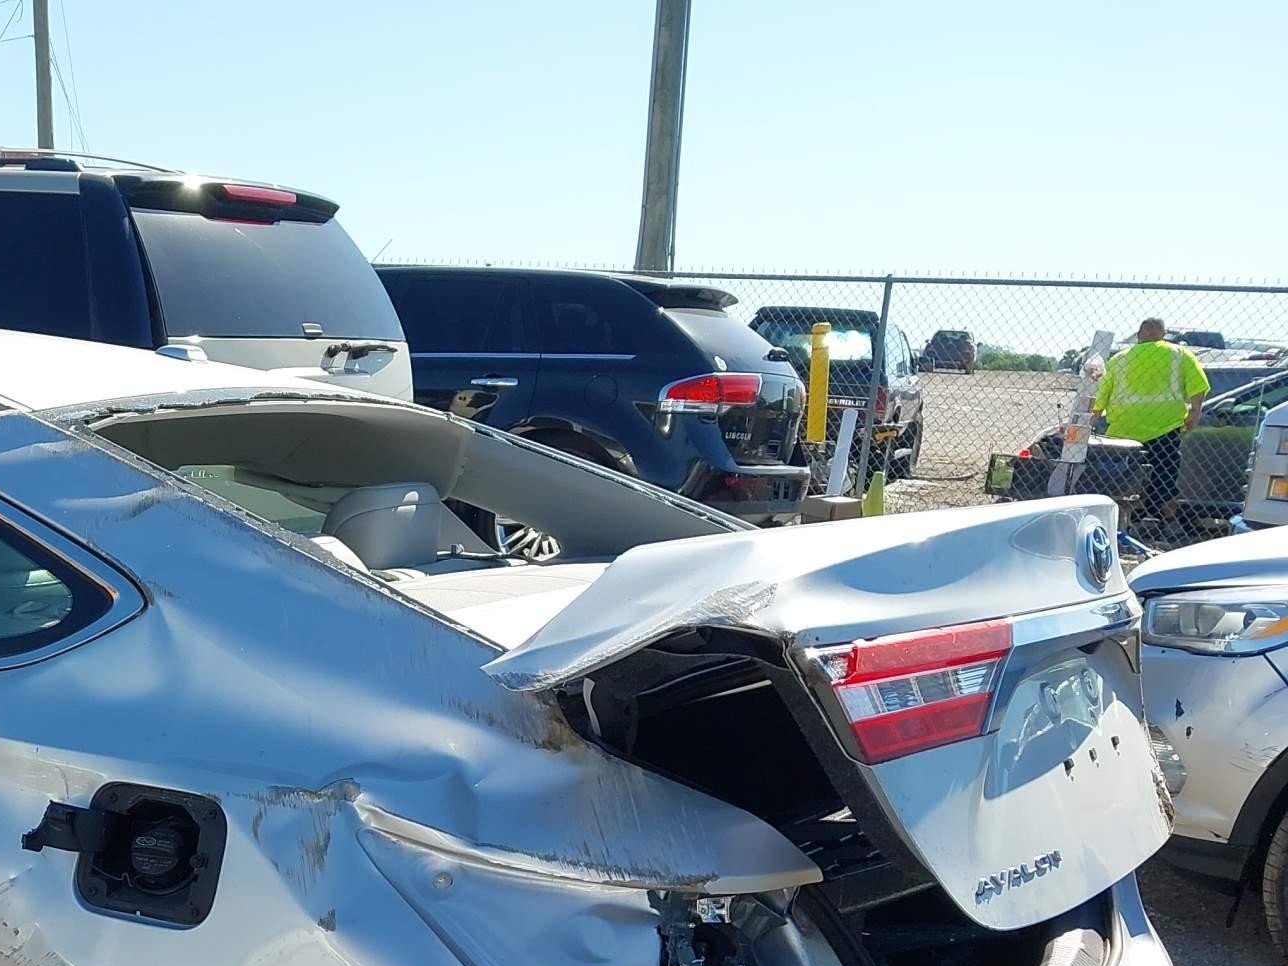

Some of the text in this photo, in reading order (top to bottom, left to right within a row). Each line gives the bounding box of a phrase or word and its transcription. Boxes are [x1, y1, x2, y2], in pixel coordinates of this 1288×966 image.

[829, 397, 867, 408] EVROLET
[725, 431, 752, 441] LINCOLN
[975, 850, 1062, 903] AVALON
